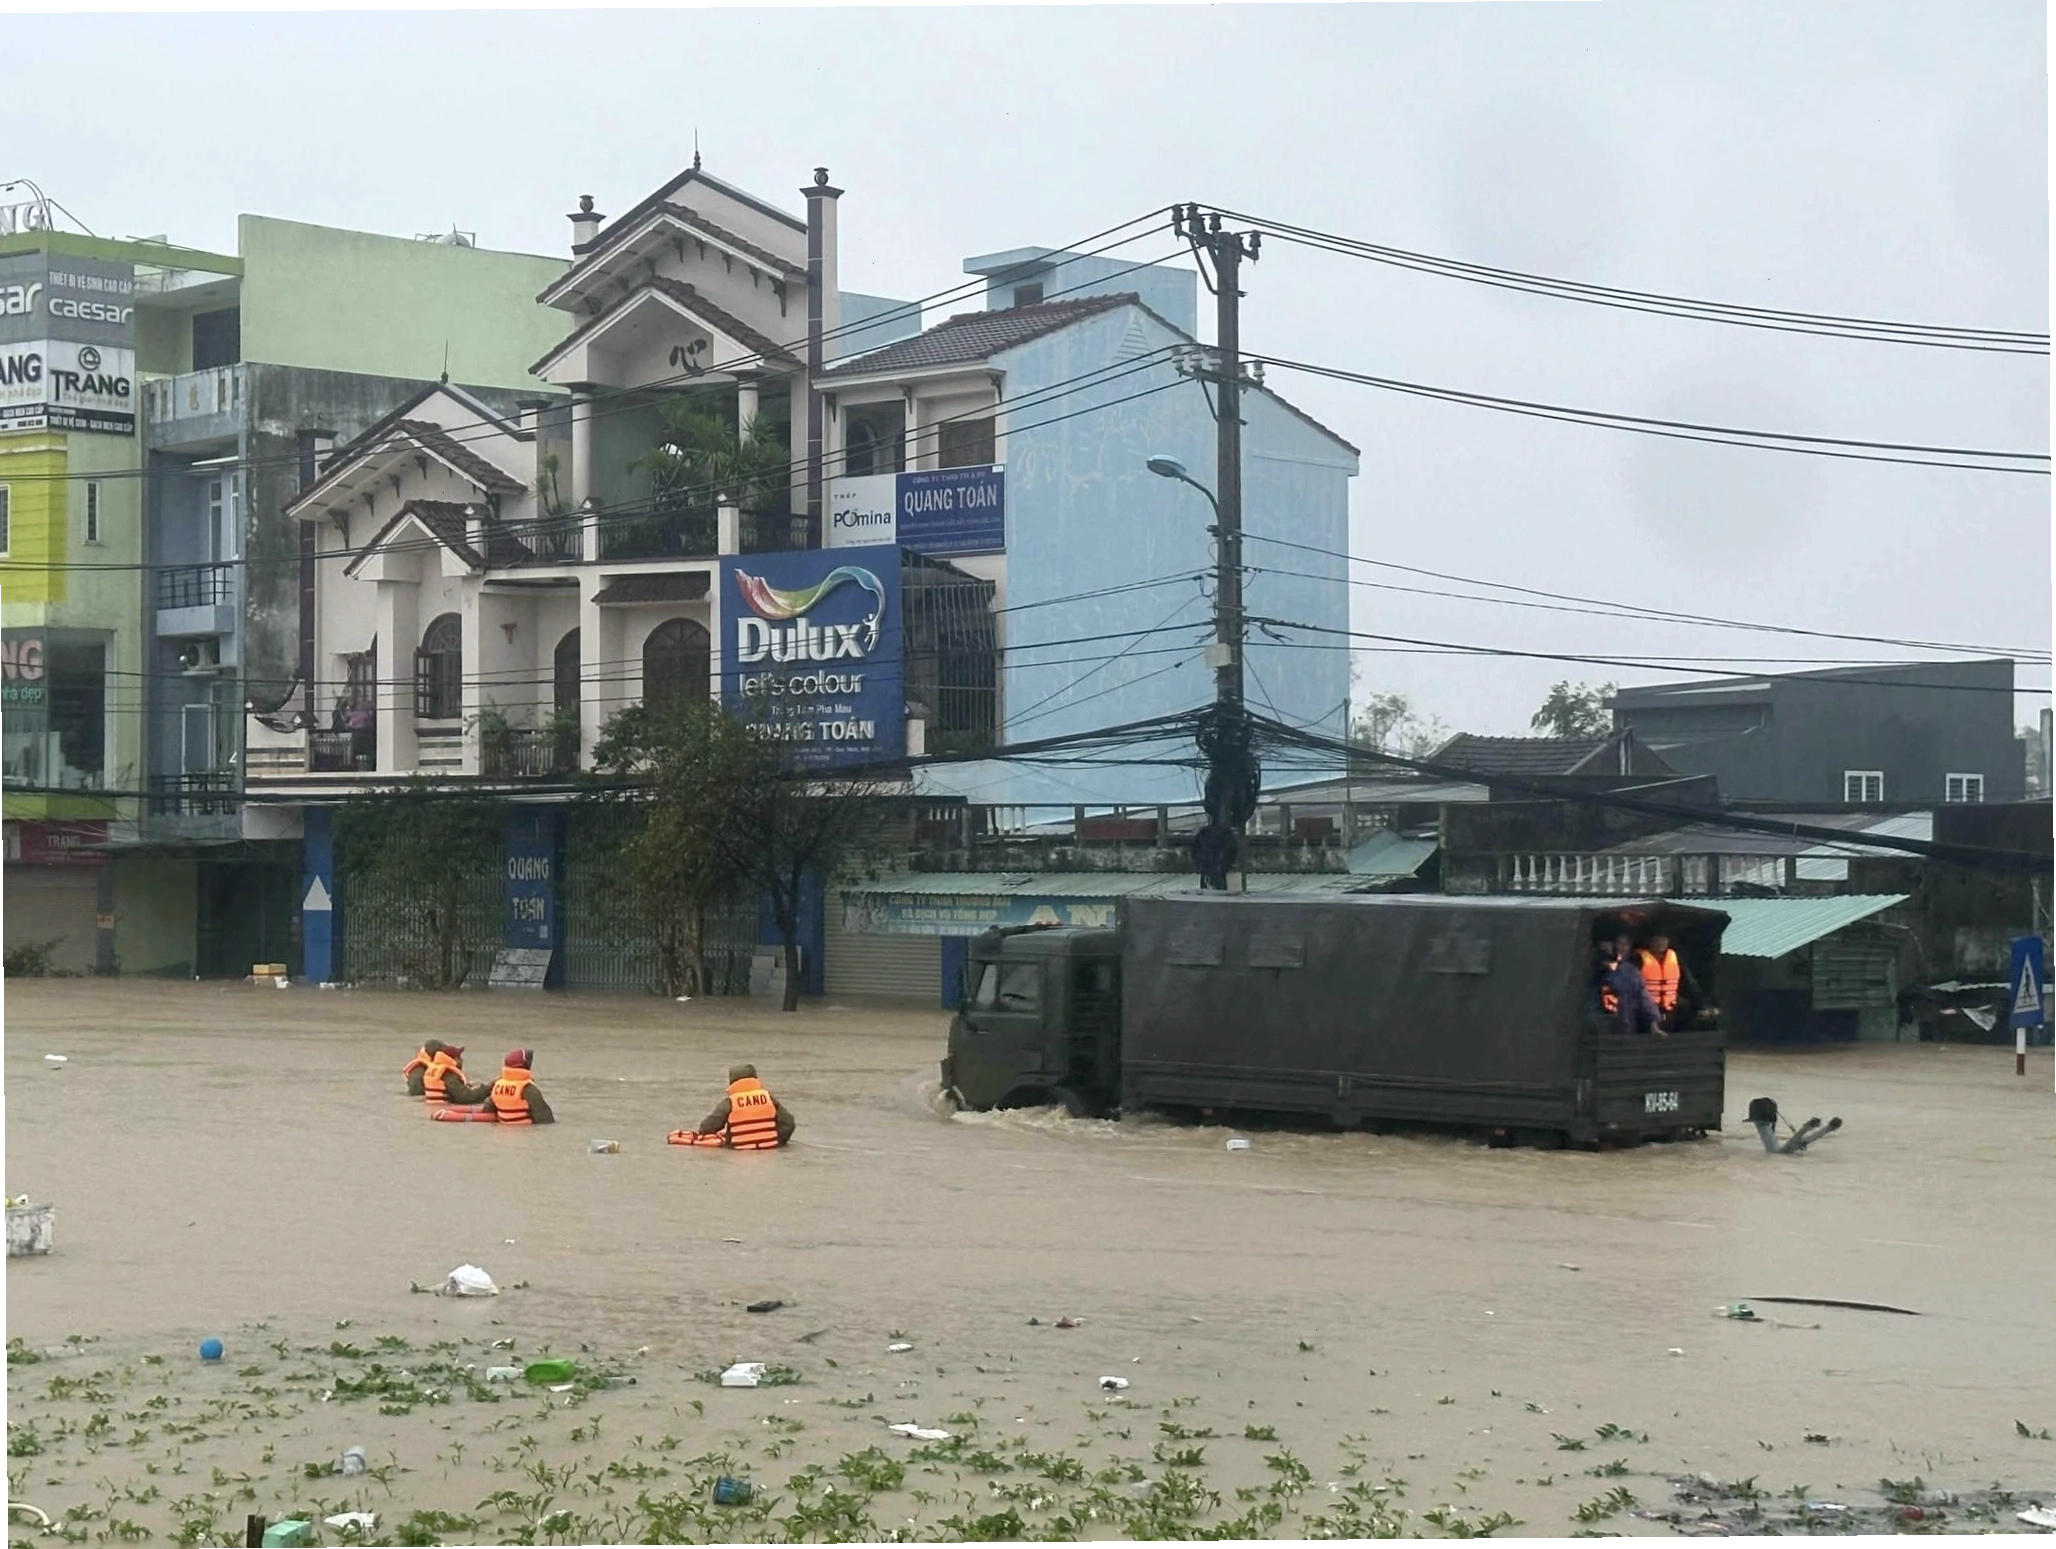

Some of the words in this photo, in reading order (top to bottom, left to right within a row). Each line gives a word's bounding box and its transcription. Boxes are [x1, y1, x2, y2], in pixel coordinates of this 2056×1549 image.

[49, 298, 133, 323] caesar
[50, 369, 130, 401] TRANG
[904, 488, 953, 517] QUANG
[957, 480, 997, 508] TOÁN
[737, 617, 865, 662] Dulux
[789, 669, 865, 695] colour
[508, 856, 549, 881] QUANG
[494, 1084, 517, 1096] CAND
[737, 1094, 768, 1107] CAND
